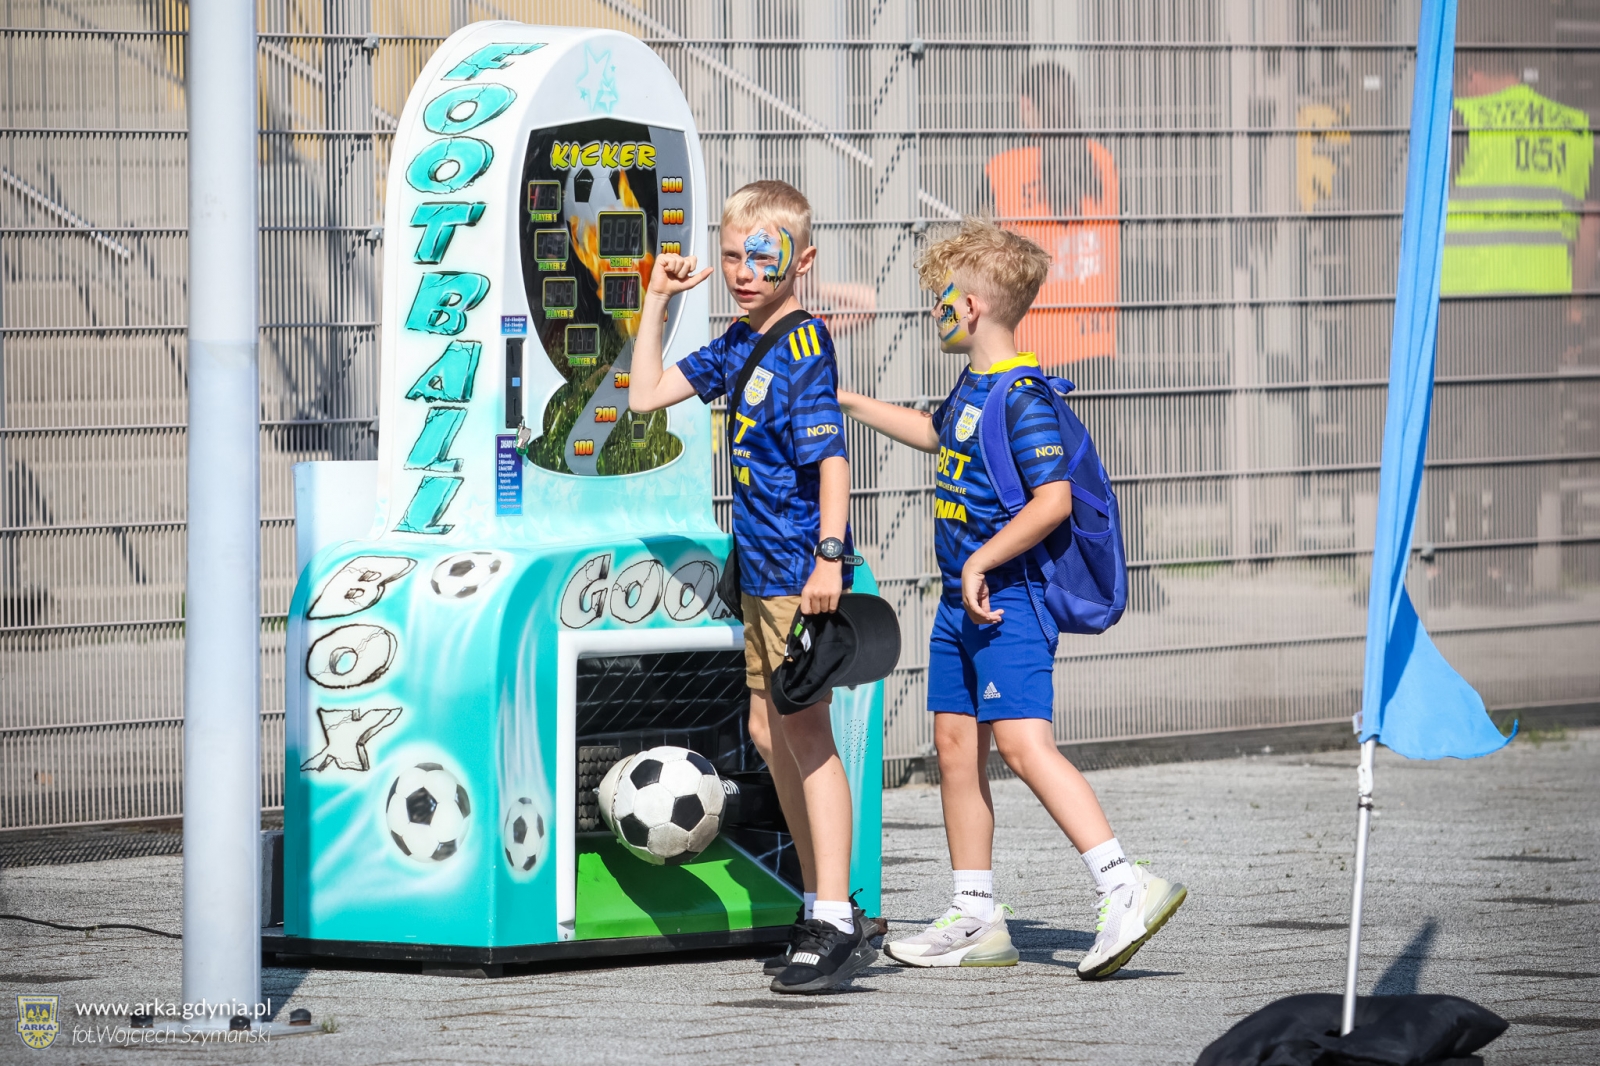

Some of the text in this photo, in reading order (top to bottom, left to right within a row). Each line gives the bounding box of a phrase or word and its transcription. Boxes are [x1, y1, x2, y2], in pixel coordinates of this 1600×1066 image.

[551, 141, 657, 169] KICKER
[661, 176, 683, 193] 900
[531, 213, 552, 222] PLAYER
[662, 208, 684, 225] 800
[538, 261, 560, 271] PLAYER
[610, 257, 633, 267] SCORE
[391, 42, 549, 535] FOOTBALL
[546, 309, 568, 318] PLAYER
[612, 310, 634, 318] RECORD
[569, 357, 591, 366] PLAYER
[594, 406, 617, 423] 200
[806, 424, 839, 438] NO10
[573, 439, 594, 456] 100
[937, 445, 972, 481] BET
[300, 555, 418, 772] BOX
[961, 889, 993, 899] adidas
